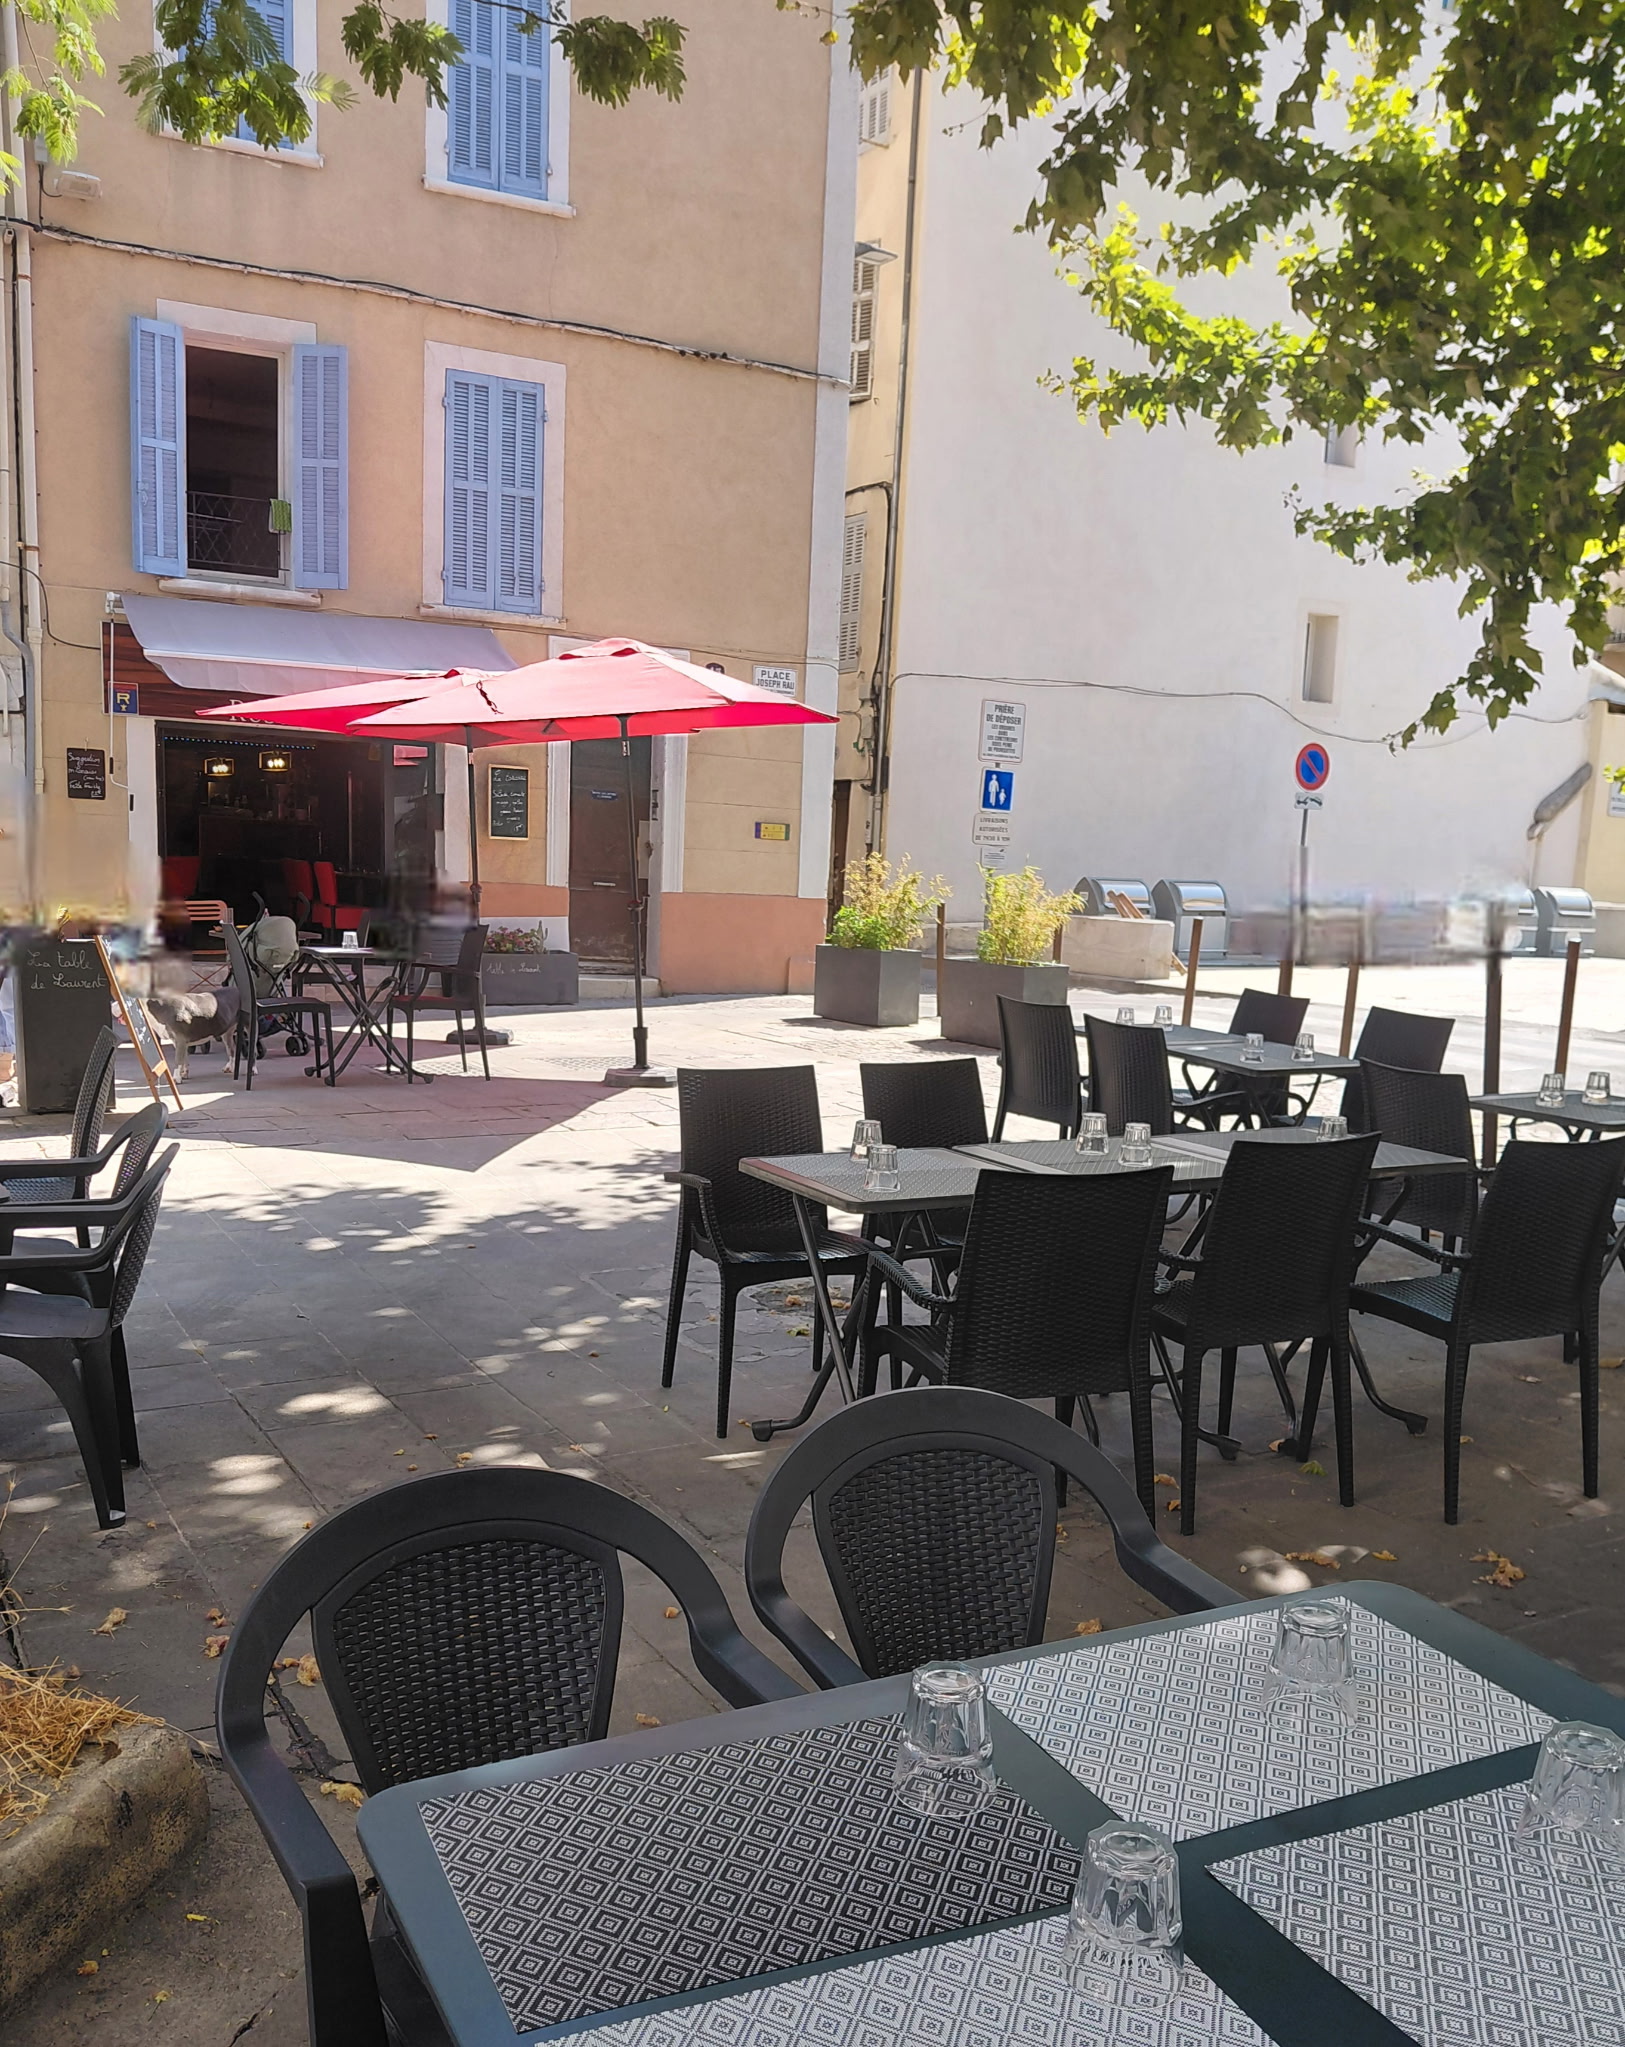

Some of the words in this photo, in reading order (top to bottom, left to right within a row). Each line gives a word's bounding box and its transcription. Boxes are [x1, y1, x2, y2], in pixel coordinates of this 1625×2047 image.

[761, 670, 791, 681] PLACE
[756, 678, 781, 688] JOSEPH
[782, 681, 795, 690] RAU
[117, 693, 130, 704] R
[994, 704, 1015, 715] PRIÈRE
[986, 713, 994, 722] DE
[995, 714, 1022, 725] DÉPOSER
[26, 949, 52, 969] La
[57, 949, 94, 970] table
[30, 973, 46, 989] de
[52, 972, 107, 989] Laurent
